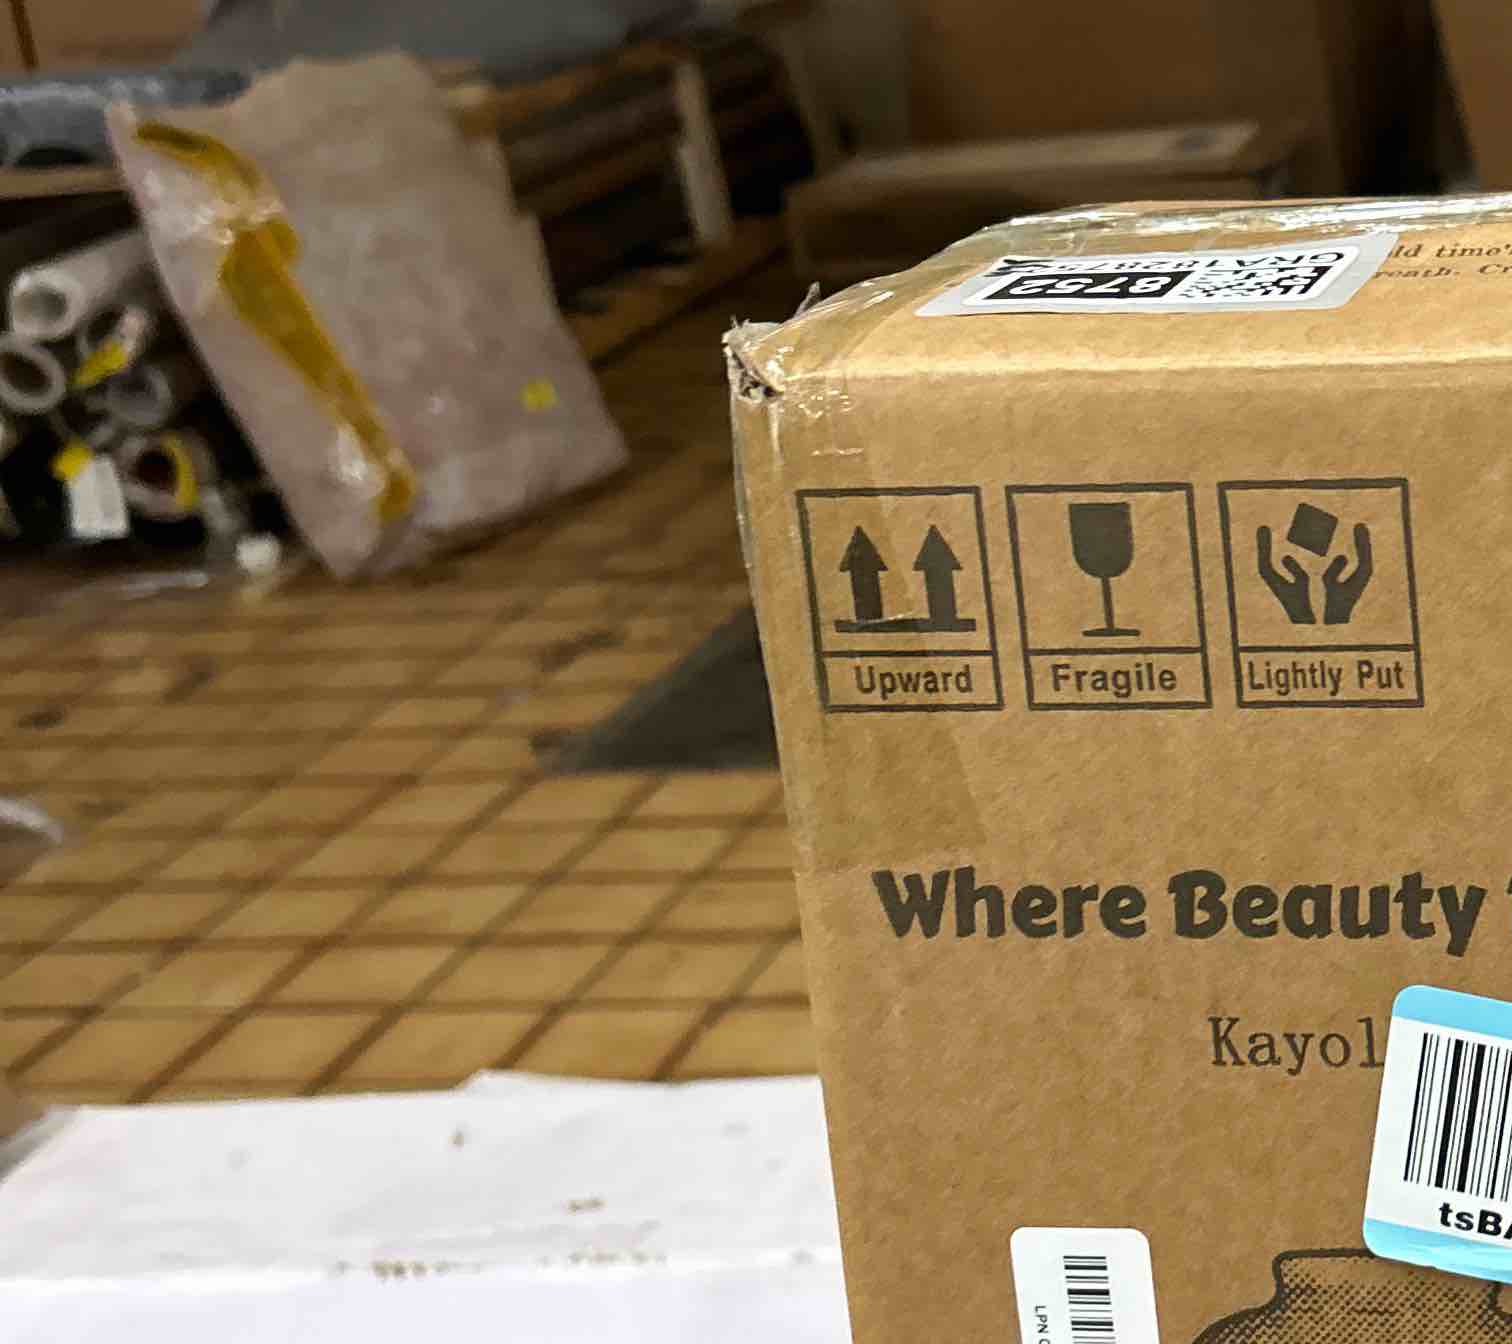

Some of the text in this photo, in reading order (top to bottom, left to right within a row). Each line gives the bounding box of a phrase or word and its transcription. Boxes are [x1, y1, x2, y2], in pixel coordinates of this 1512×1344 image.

[1387, 243, 1423, 258] ld
[1008, 276, 1172, 296] 8752
[853, 664, 973, 700] Upward
[1050, 662, 1178, 698] Fragile
[1247, 660, 1404, 696] Lightly Put
[871, 864, 1148, 940] Where
[1168, 869, 1487, 957] Beauty
[1034, 1304, 1049, 1334] LPN
